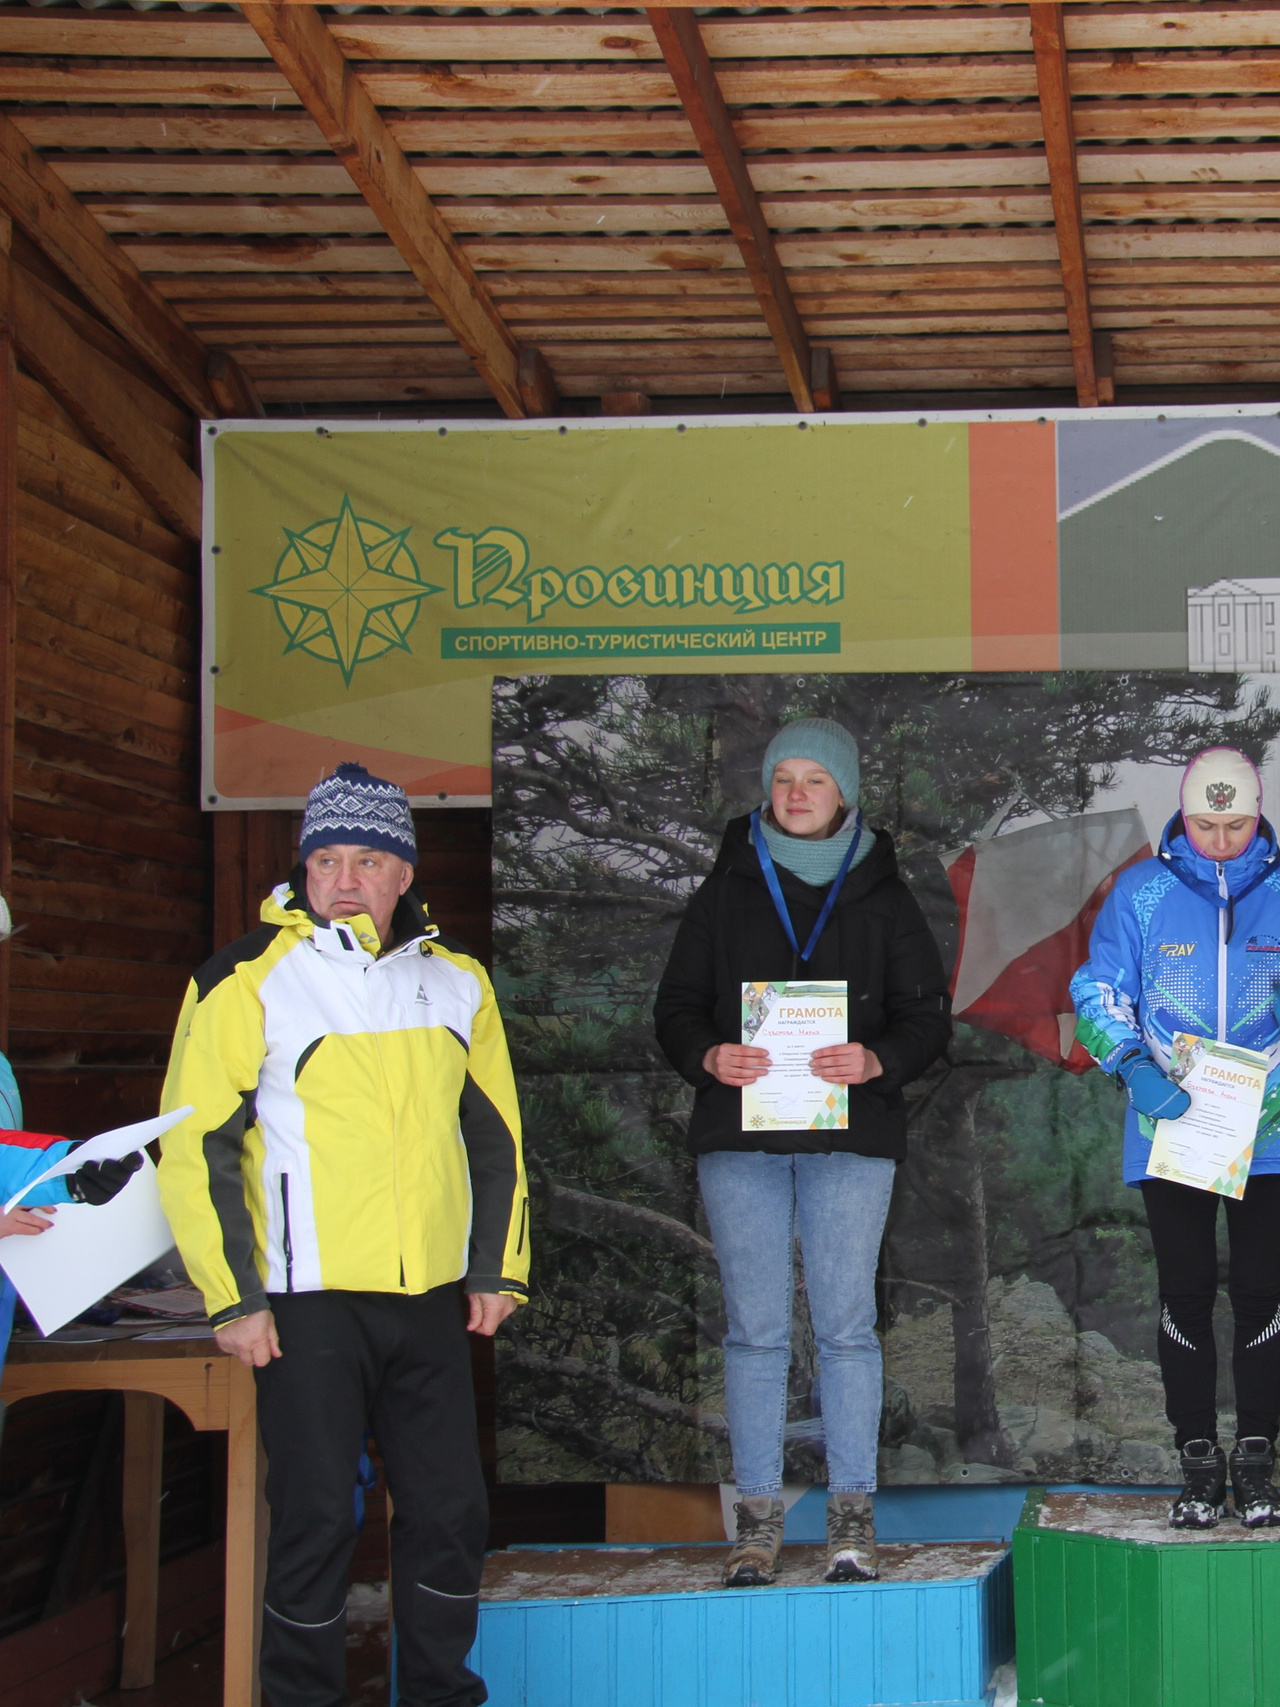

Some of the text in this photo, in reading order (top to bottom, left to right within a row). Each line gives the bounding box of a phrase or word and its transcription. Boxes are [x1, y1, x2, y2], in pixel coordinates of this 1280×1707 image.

[433, 526, 845, 624] Провинция
[454, 629, 828, 653] СПОРТИВНО-ТУРИСТИЧЕСКИЙ ЦЕНТР
[1159, 943, 1196, 957] RAY
[779, 1007, 844, 1018] ГРАМОТА
[1203, 1065, 1261, 1090] ГРАМОТА
